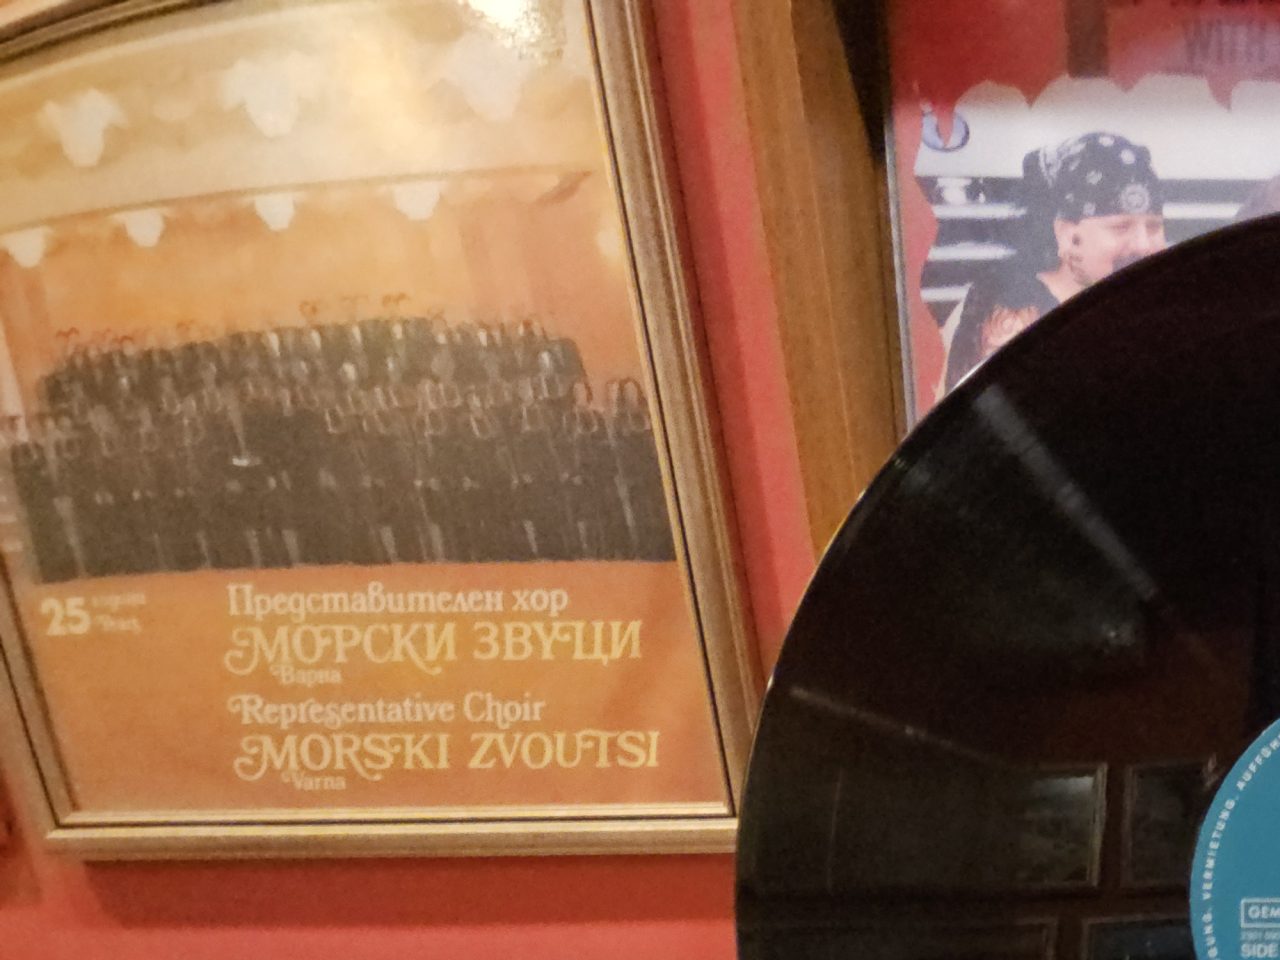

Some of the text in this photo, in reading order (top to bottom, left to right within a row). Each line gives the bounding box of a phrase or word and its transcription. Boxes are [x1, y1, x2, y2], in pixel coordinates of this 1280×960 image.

[40, 596, 91, 636] 25
[226, 580, 569, 623] Представителен хор
[223, 619, 643, 676] МОРСКИ ЗВУЦИ
[268, 664, 343, 688] Варна
[227, 690, 547, 730] Representative Choir
[232, 727, 661, 781] MORSKI ZVOUTSI
[281, 771, 347, 790] Varna
[1240, 942, 1279, 958] SIDE
